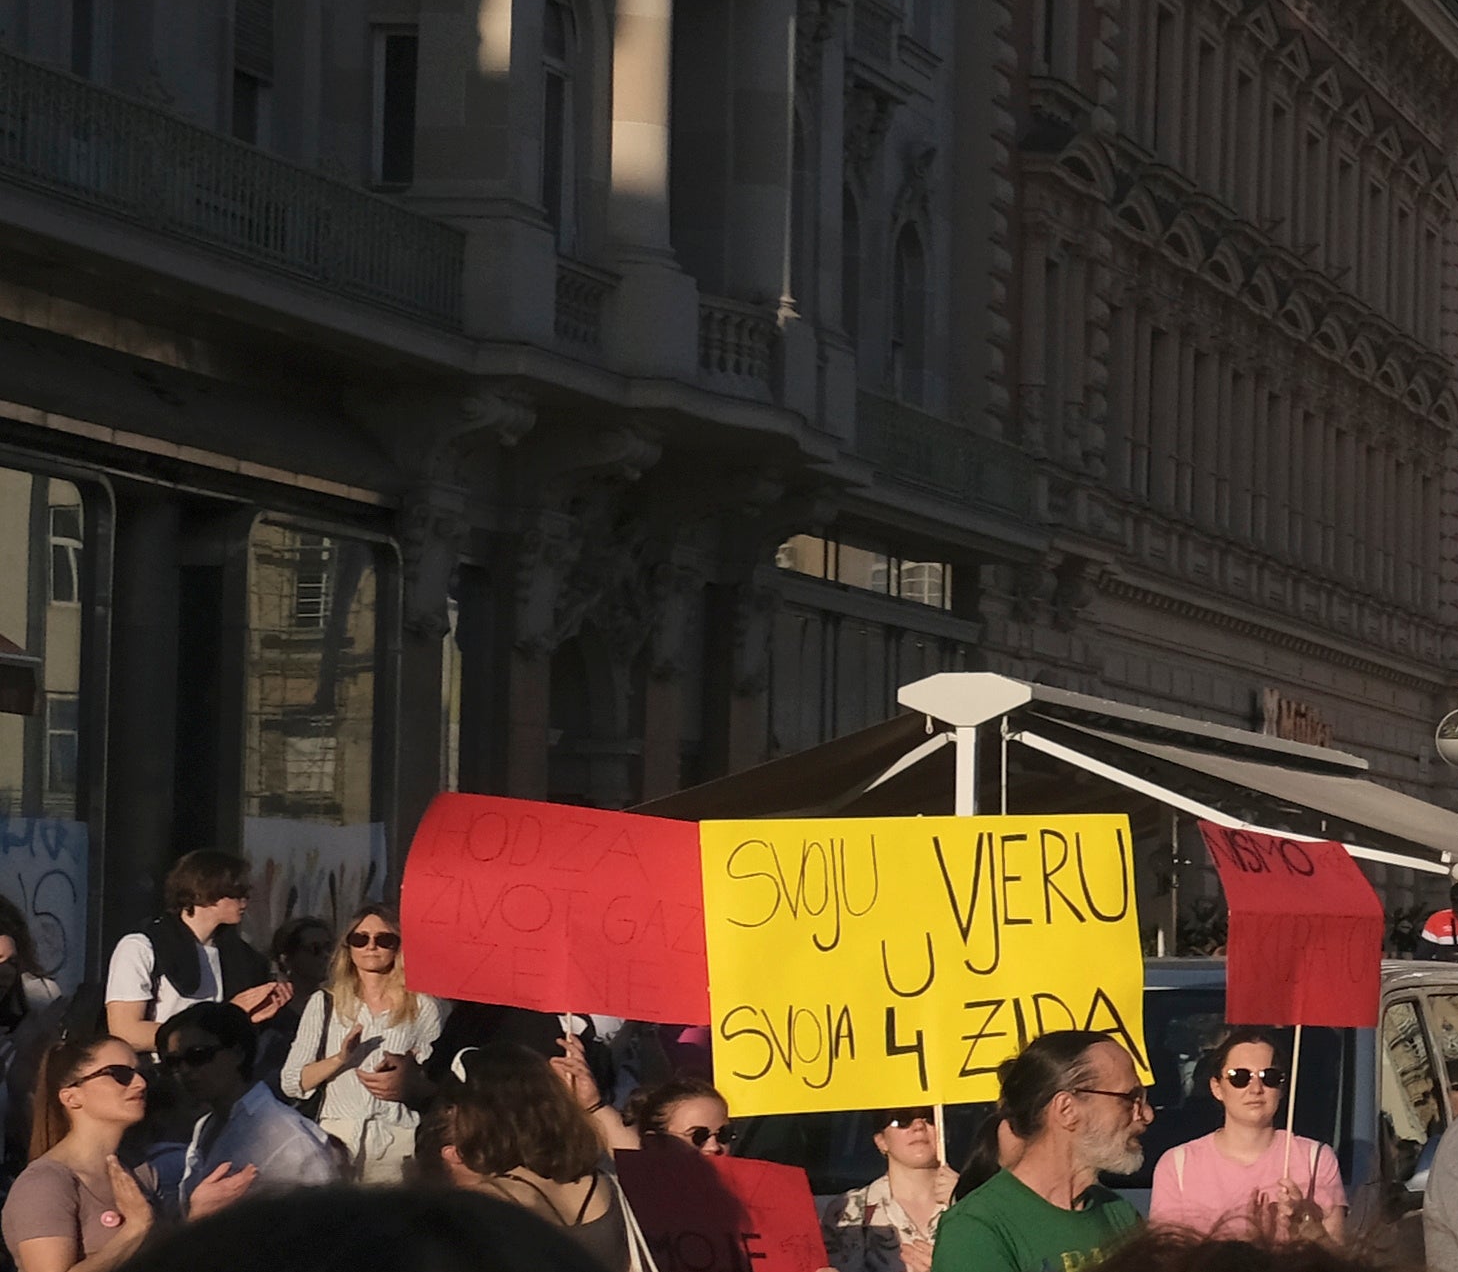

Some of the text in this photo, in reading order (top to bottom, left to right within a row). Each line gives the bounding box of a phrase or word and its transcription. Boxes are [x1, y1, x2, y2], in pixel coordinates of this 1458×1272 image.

[430, 810, 651, 885] HOD ZA
[421, 863, 703, 955] ŽIVOT GAZ
[725, 828, 1130, 975] SVOJU VJERU
[880, 932, 936, 998] U
[720, 1003, 856, 1089] SVOJA
[885, 1005, 929, 1092] 4
